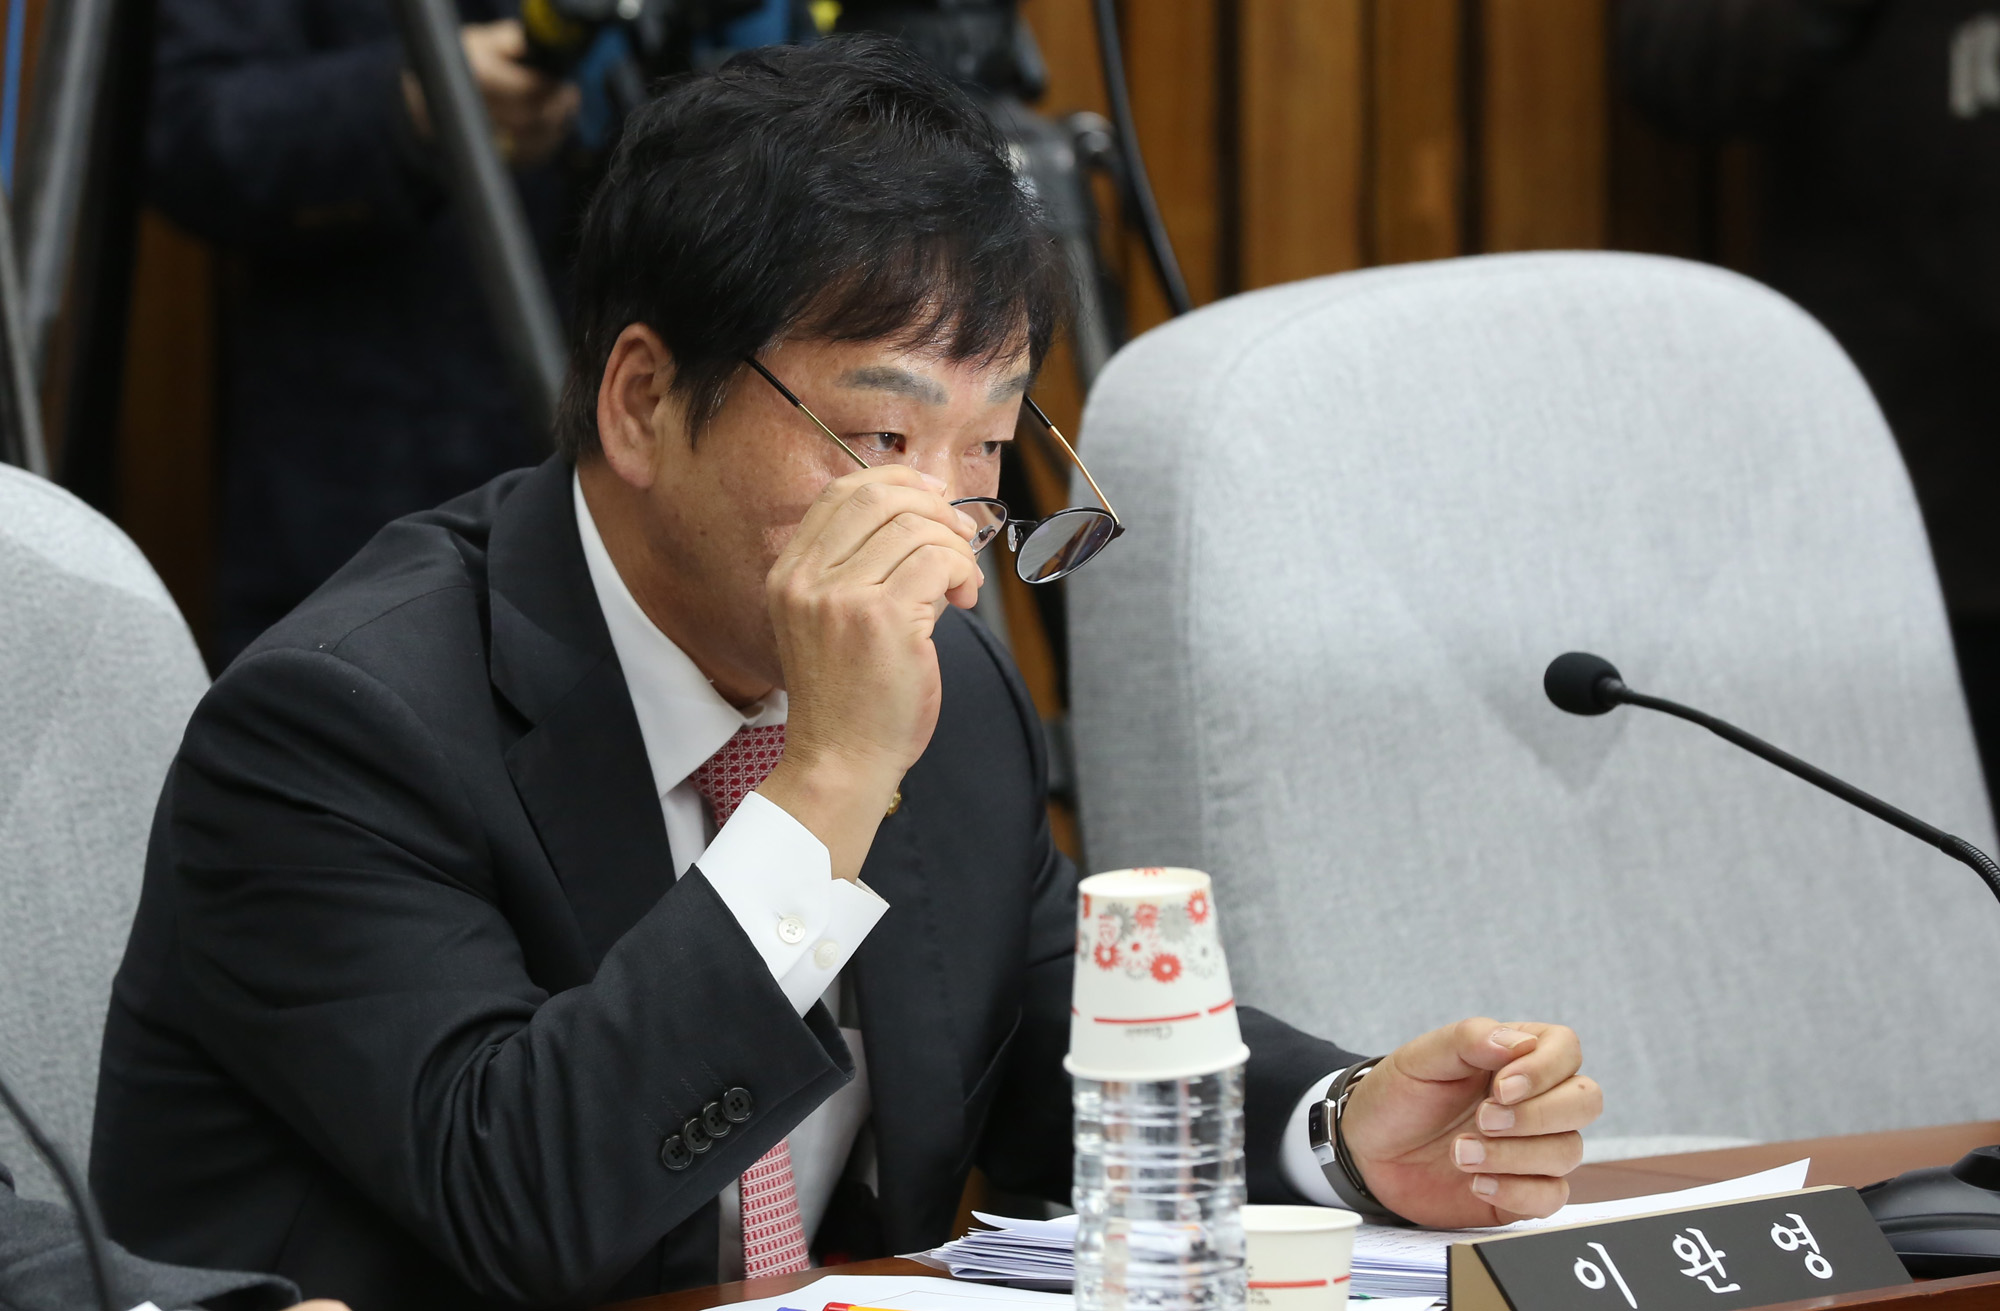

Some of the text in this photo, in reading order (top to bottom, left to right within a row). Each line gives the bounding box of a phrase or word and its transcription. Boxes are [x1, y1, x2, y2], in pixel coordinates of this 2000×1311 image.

[1573, 1213, 1834, 1310] 이 완 영
